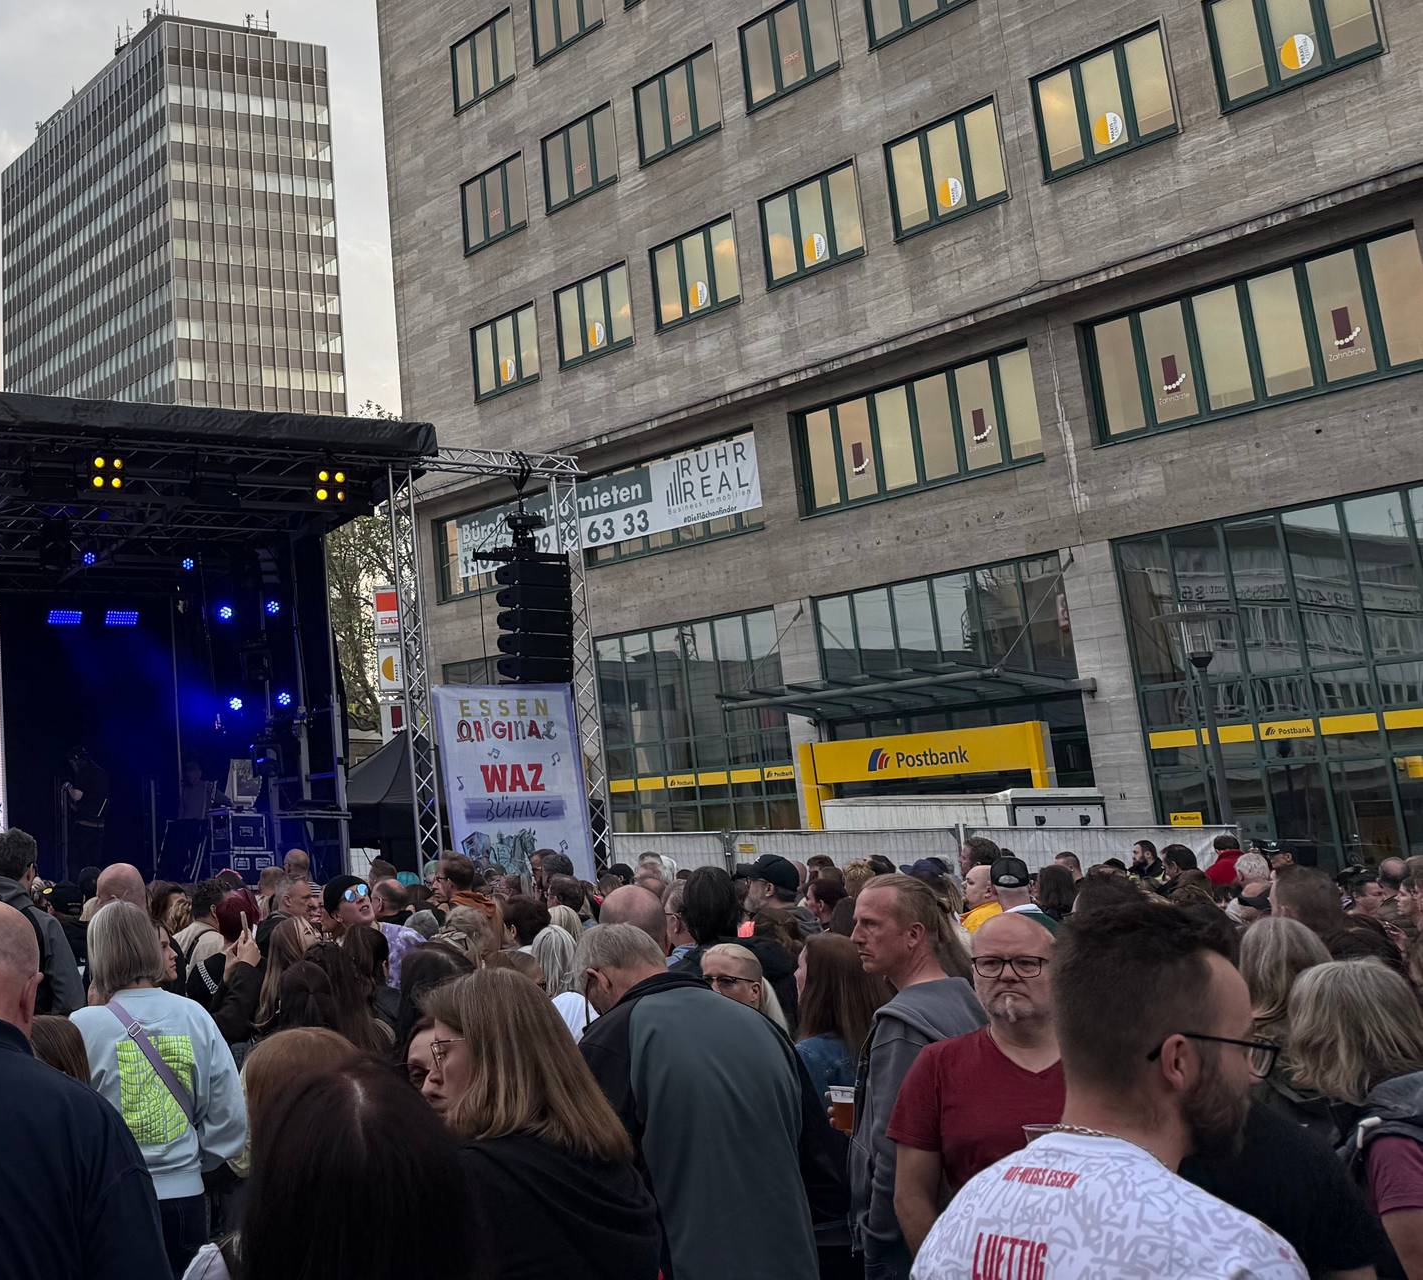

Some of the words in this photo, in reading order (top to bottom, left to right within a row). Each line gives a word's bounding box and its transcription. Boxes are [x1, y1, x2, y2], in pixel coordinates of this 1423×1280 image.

[680, 441, 746, 478] RUHR
[577, 483, 643, 512] mieten
[682, 467, 749, 503] REAL
[587, 518, 615, 543] 63
[623, 509, 649, 536] 33
[459, 699, 549, 717] ESSEN
[1278, 726, 1312, 735] Postbank
[896, 745, 970, 768] Postbank
[480, 763, 546, 793] WAZ
[484, 795, 551, 821] BÜHNE
[1044, 1169, 1081, 1190] ESSEN
[972, 1232, 1048, 1280] LUETTIG
